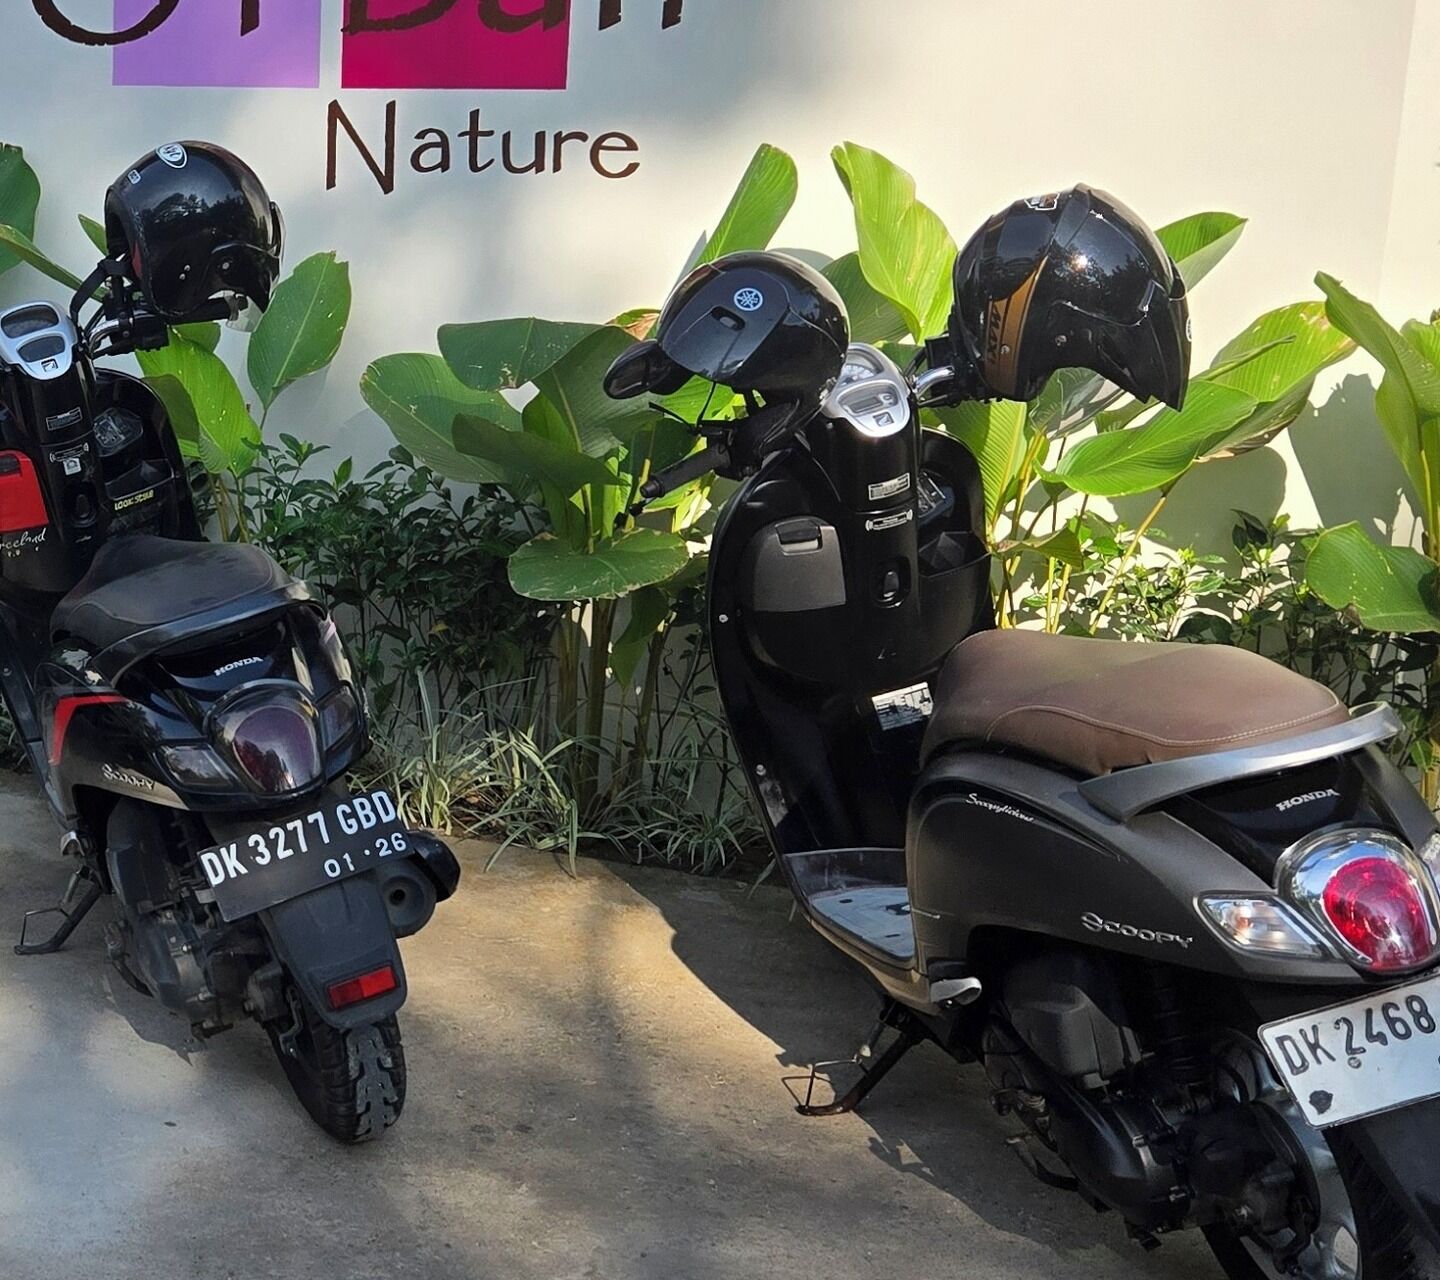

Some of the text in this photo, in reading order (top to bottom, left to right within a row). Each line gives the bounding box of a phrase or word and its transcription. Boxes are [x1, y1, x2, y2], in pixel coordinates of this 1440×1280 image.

[325, 100, 640, 195] Nature
[214, 656, 264, 677] HONDA
[200, 790, 396, 887] DK 3277 GBD
[1275, 787, 1341, 812] HONDA
[1275, 995, 1437, 1076] DK 2468
